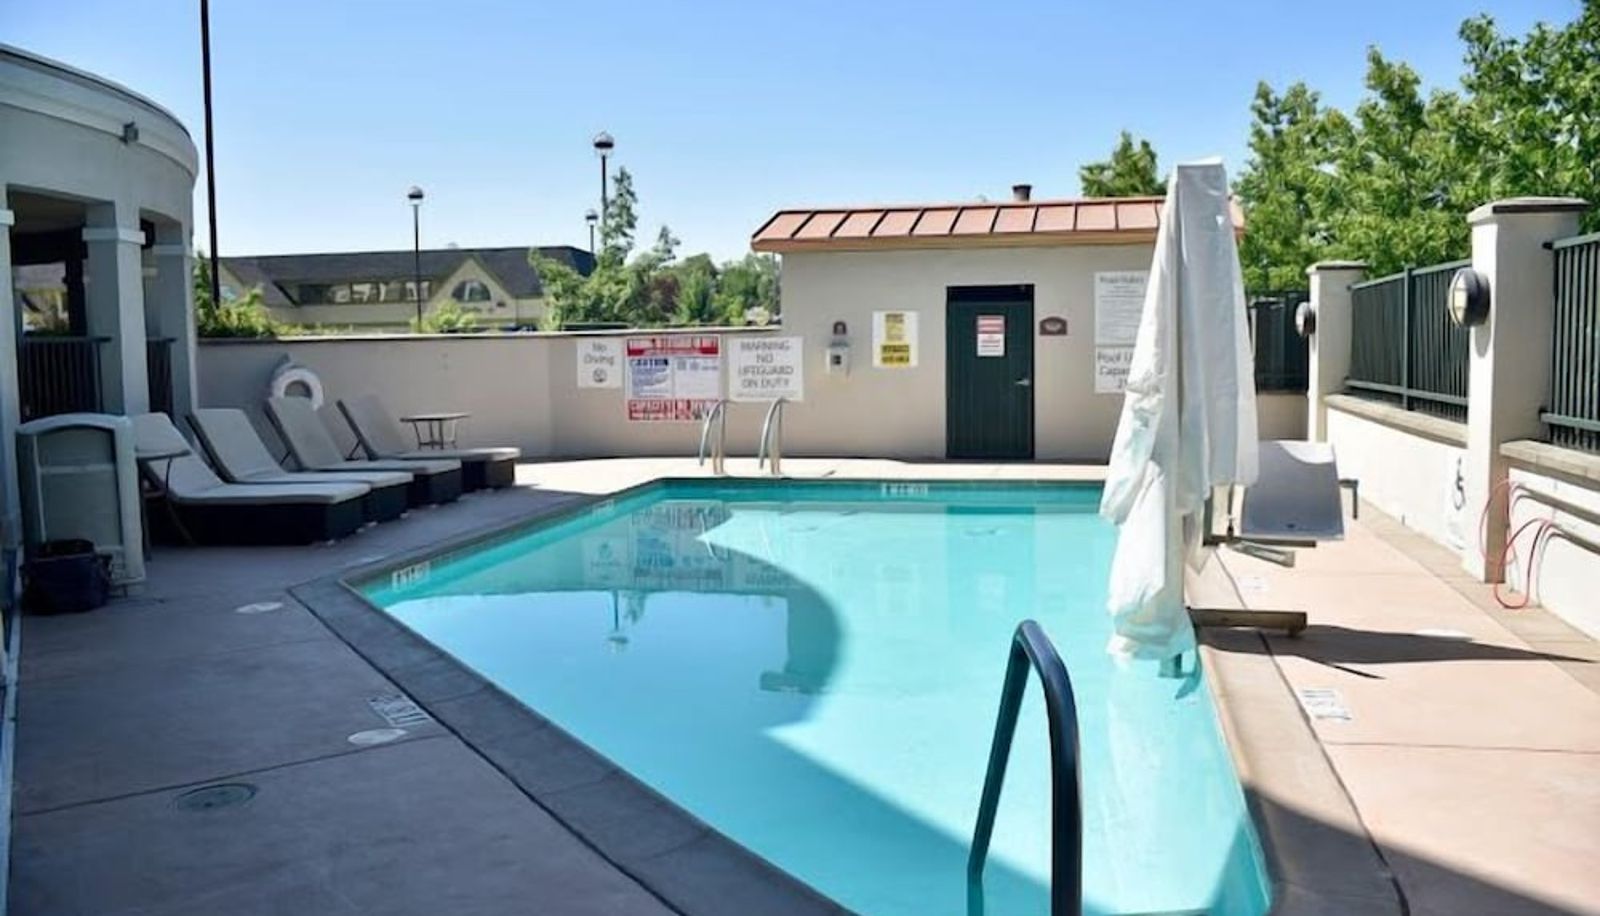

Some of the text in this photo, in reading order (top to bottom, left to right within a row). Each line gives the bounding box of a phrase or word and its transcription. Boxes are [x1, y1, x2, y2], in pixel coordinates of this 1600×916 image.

[592, 341, 607, 352] No
[740, 339, 791, 351] WARNING
[583, 353, 615, 366] Diving
[756, 352, 774, 364] NO
[1097, 352, 1121, 363] Pool
[737, 364, 794, 377] LIFEGUARD
[741, 376, 790, 390] ON DUTY
